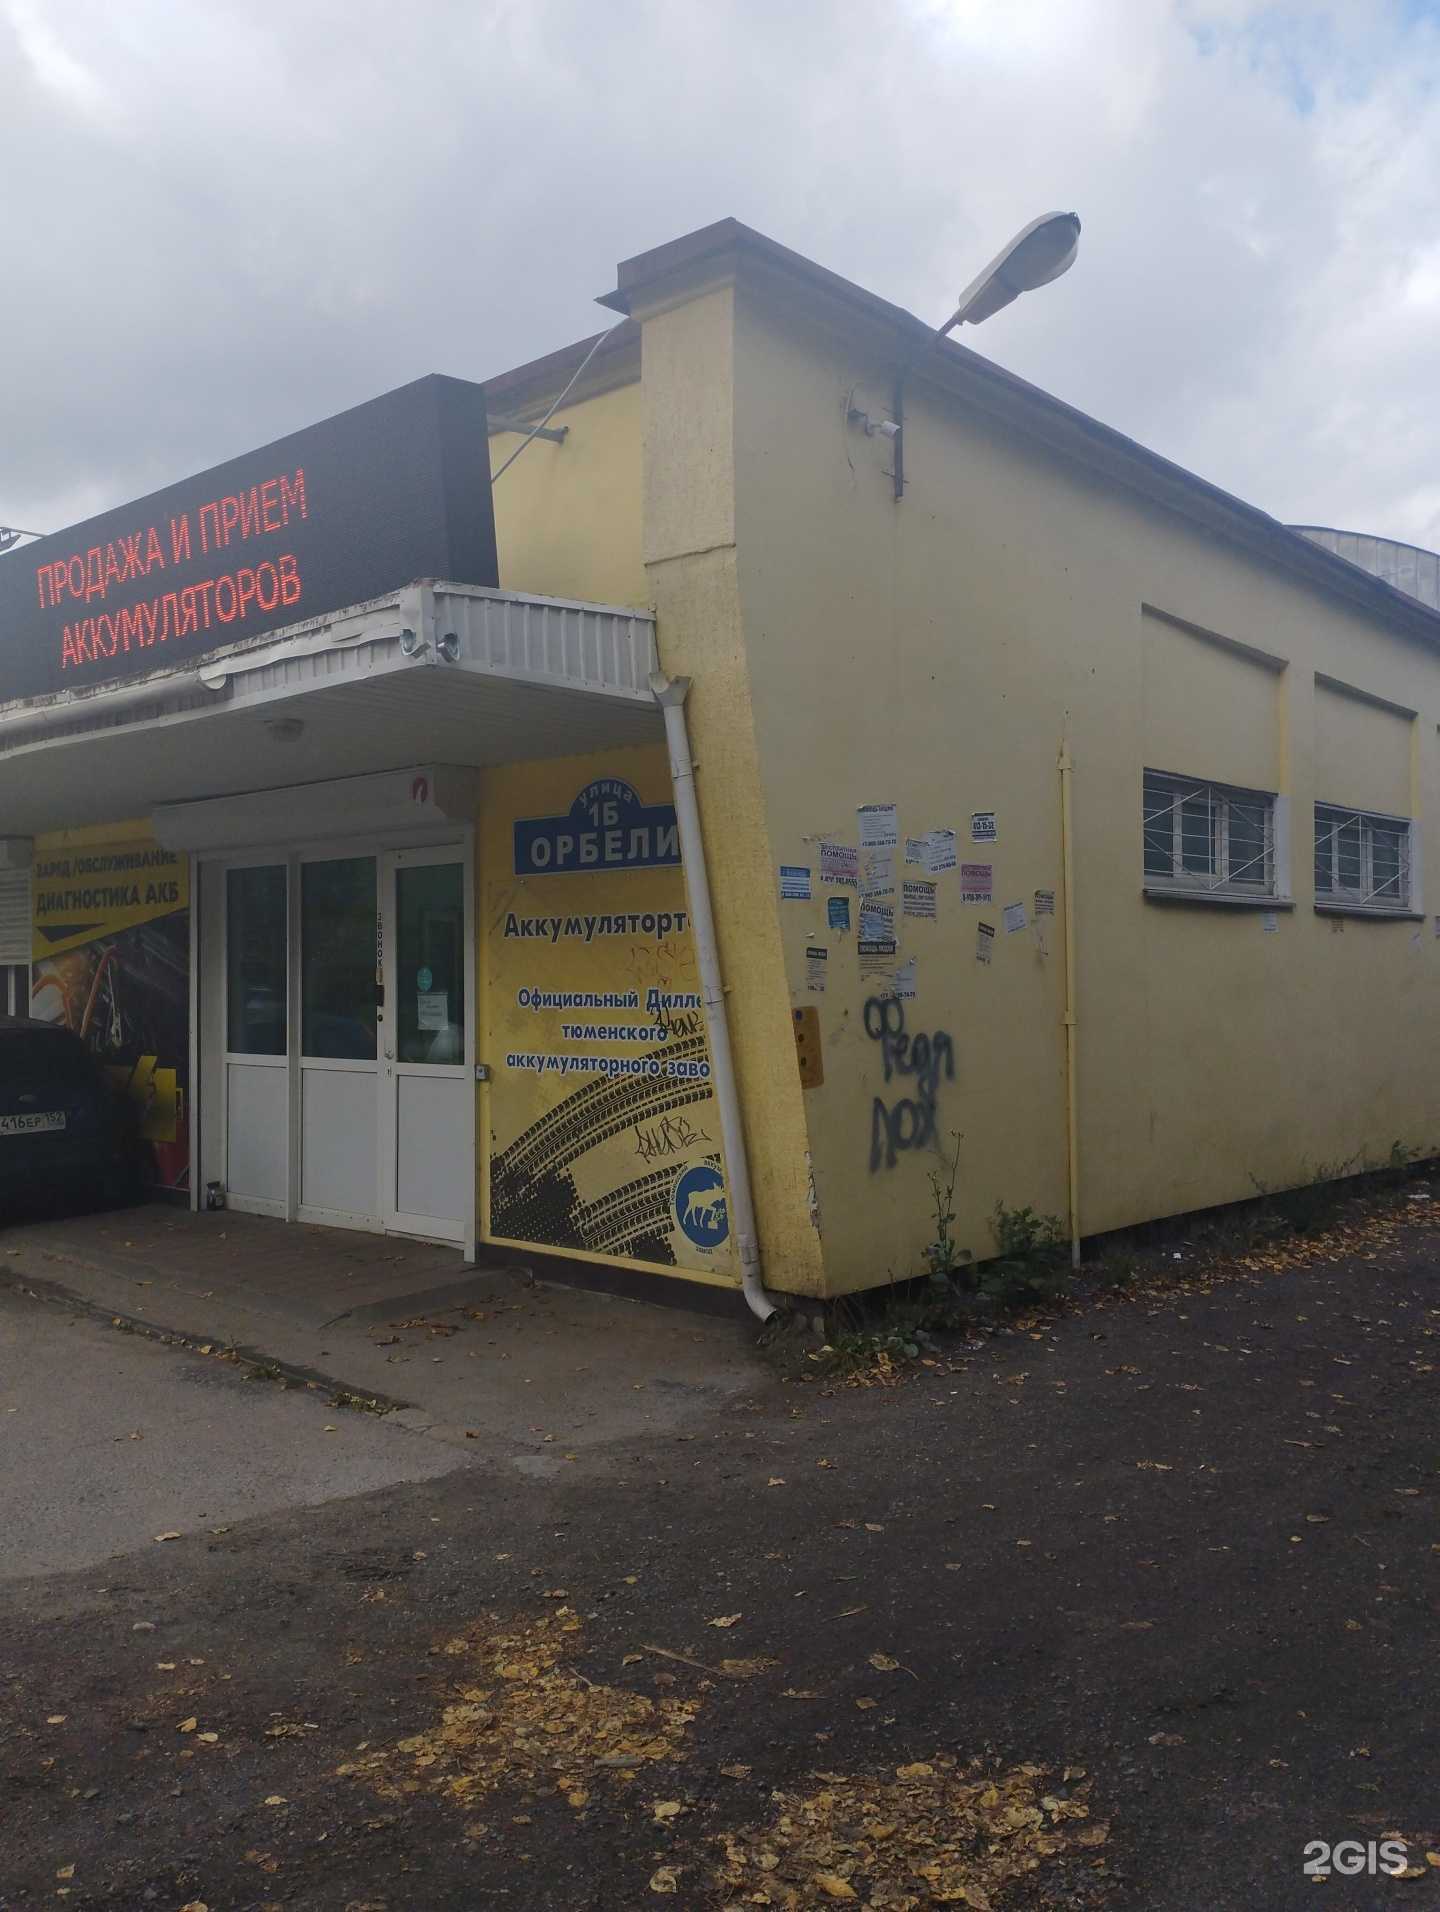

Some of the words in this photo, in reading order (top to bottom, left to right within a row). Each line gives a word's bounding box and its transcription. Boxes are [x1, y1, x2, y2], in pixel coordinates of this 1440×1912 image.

[37, 527, 165, 609] ПРОДАЖА
[170, 514, 191, 564] И
[200, 469, 309, 555] ПРИЕМ
[61, 554, 302, 669] АККУМУЛЯТОРОВ
[579, 783, 632, 808] улица
[588, 801, 619, 827] 1Б
[36, 883, 141, 917] ДИАГНОСТИКА
[145, 881, 179, 905] АКБ
[518, 987, 638, 1012] Официальный
[563, 1024, 667, 1041] тюменского
[507, 1054, 660, 1077] аккумуляторного
[668, 1061, 710, 1077] заво
